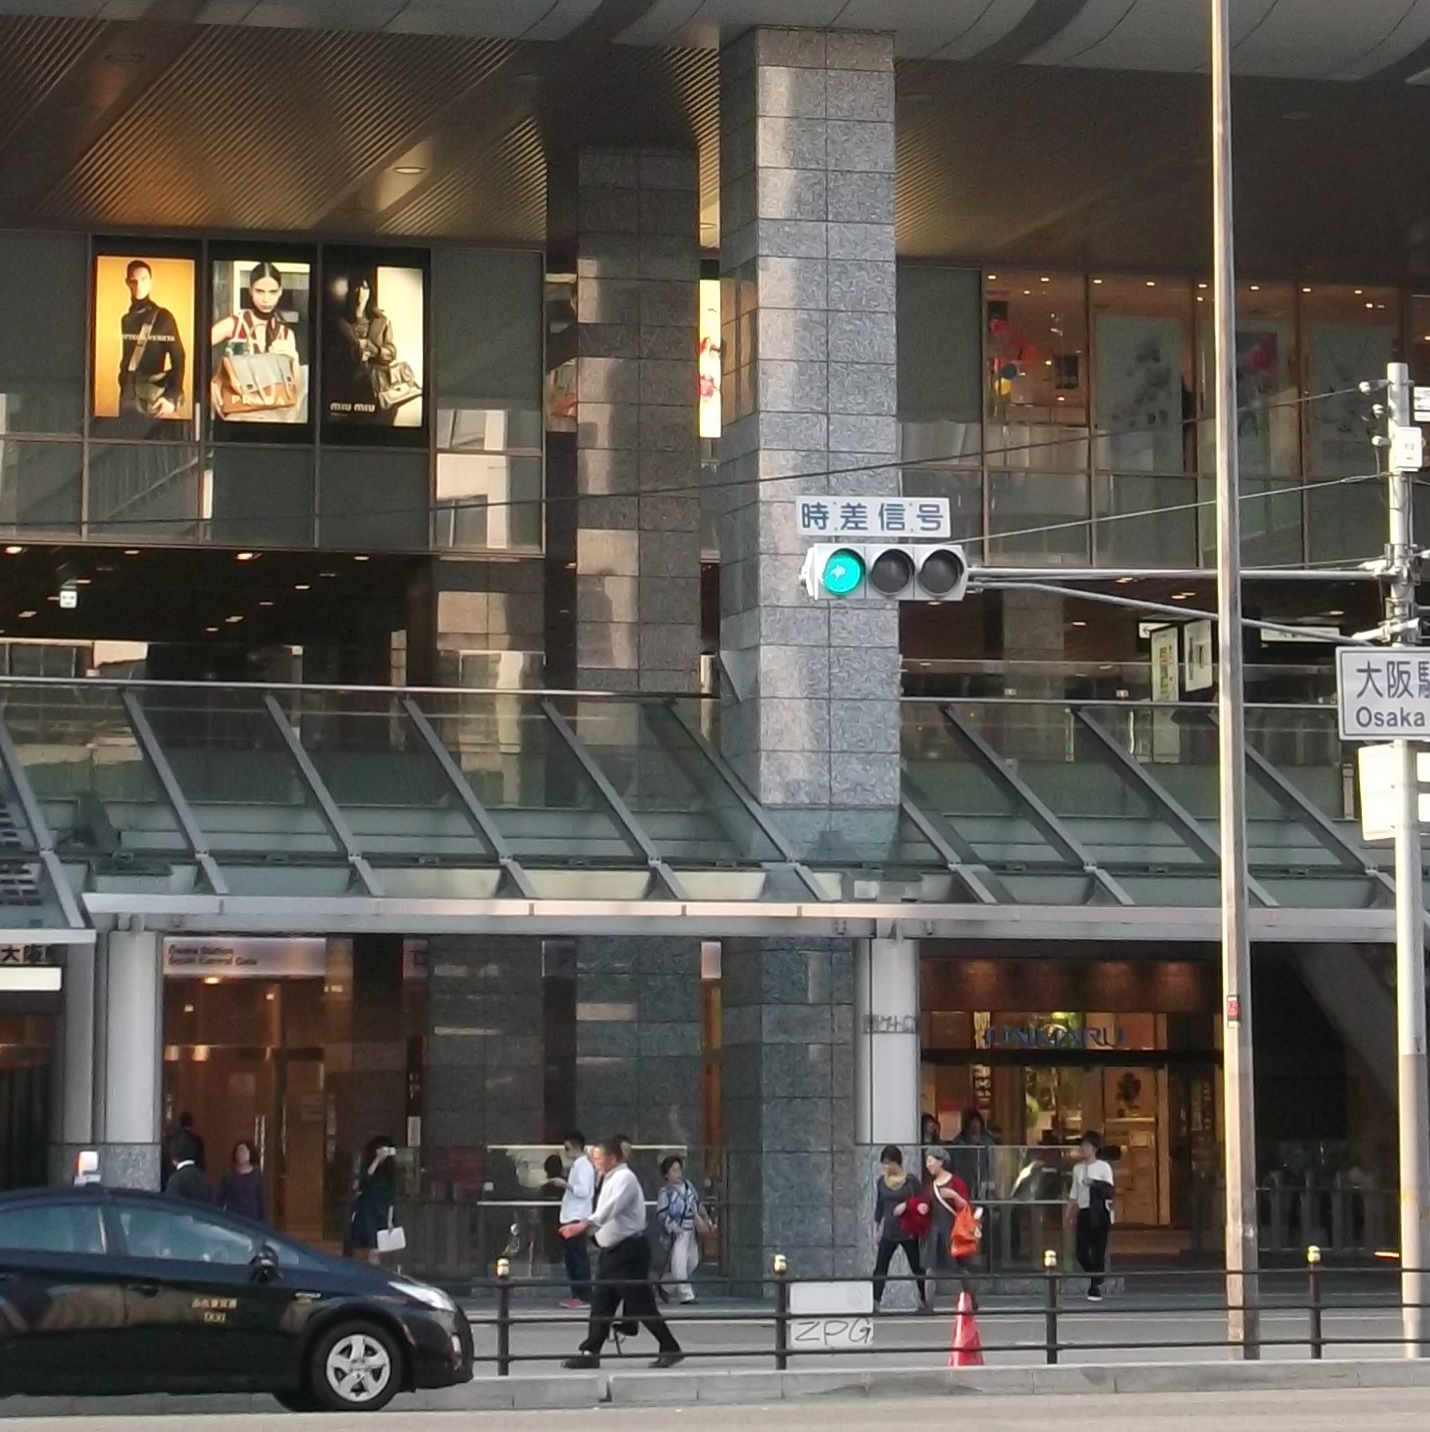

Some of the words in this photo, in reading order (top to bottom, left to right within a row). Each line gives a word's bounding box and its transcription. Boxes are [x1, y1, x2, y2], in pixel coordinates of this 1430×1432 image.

[801, 501, 944, 531] 時差信号
[1355, 706, 1425, 728] Osaka
